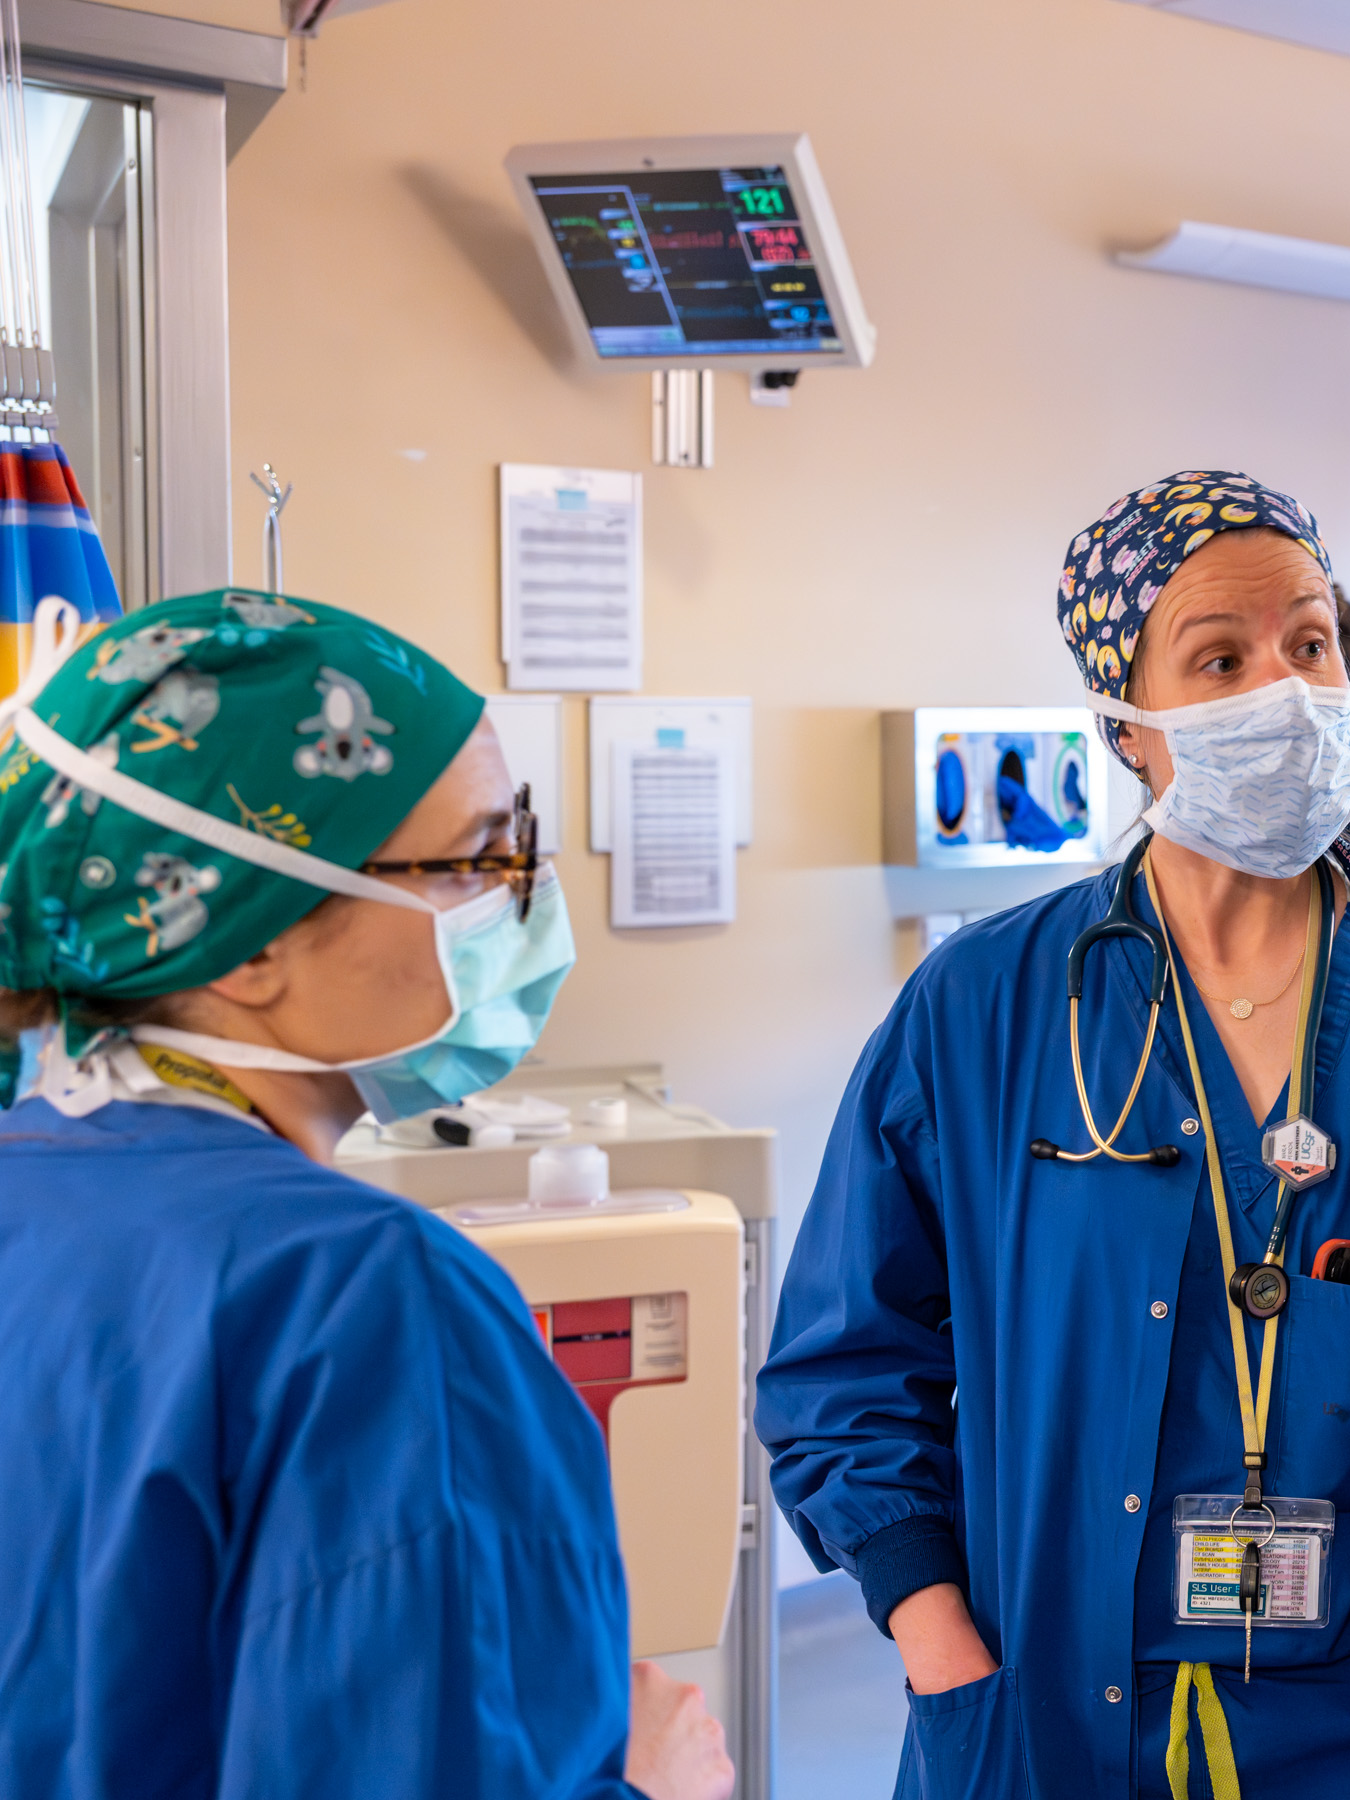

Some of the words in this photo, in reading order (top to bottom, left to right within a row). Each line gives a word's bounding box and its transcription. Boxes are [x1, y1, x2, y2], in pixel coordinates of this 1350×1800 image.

[739, 188, 784, 215] 121
[1301, 1130, 1315, 1160] UCSF
[1192, 1583, 1207, 1592] SLS
[1210, 1584, 1232, 1593] User
